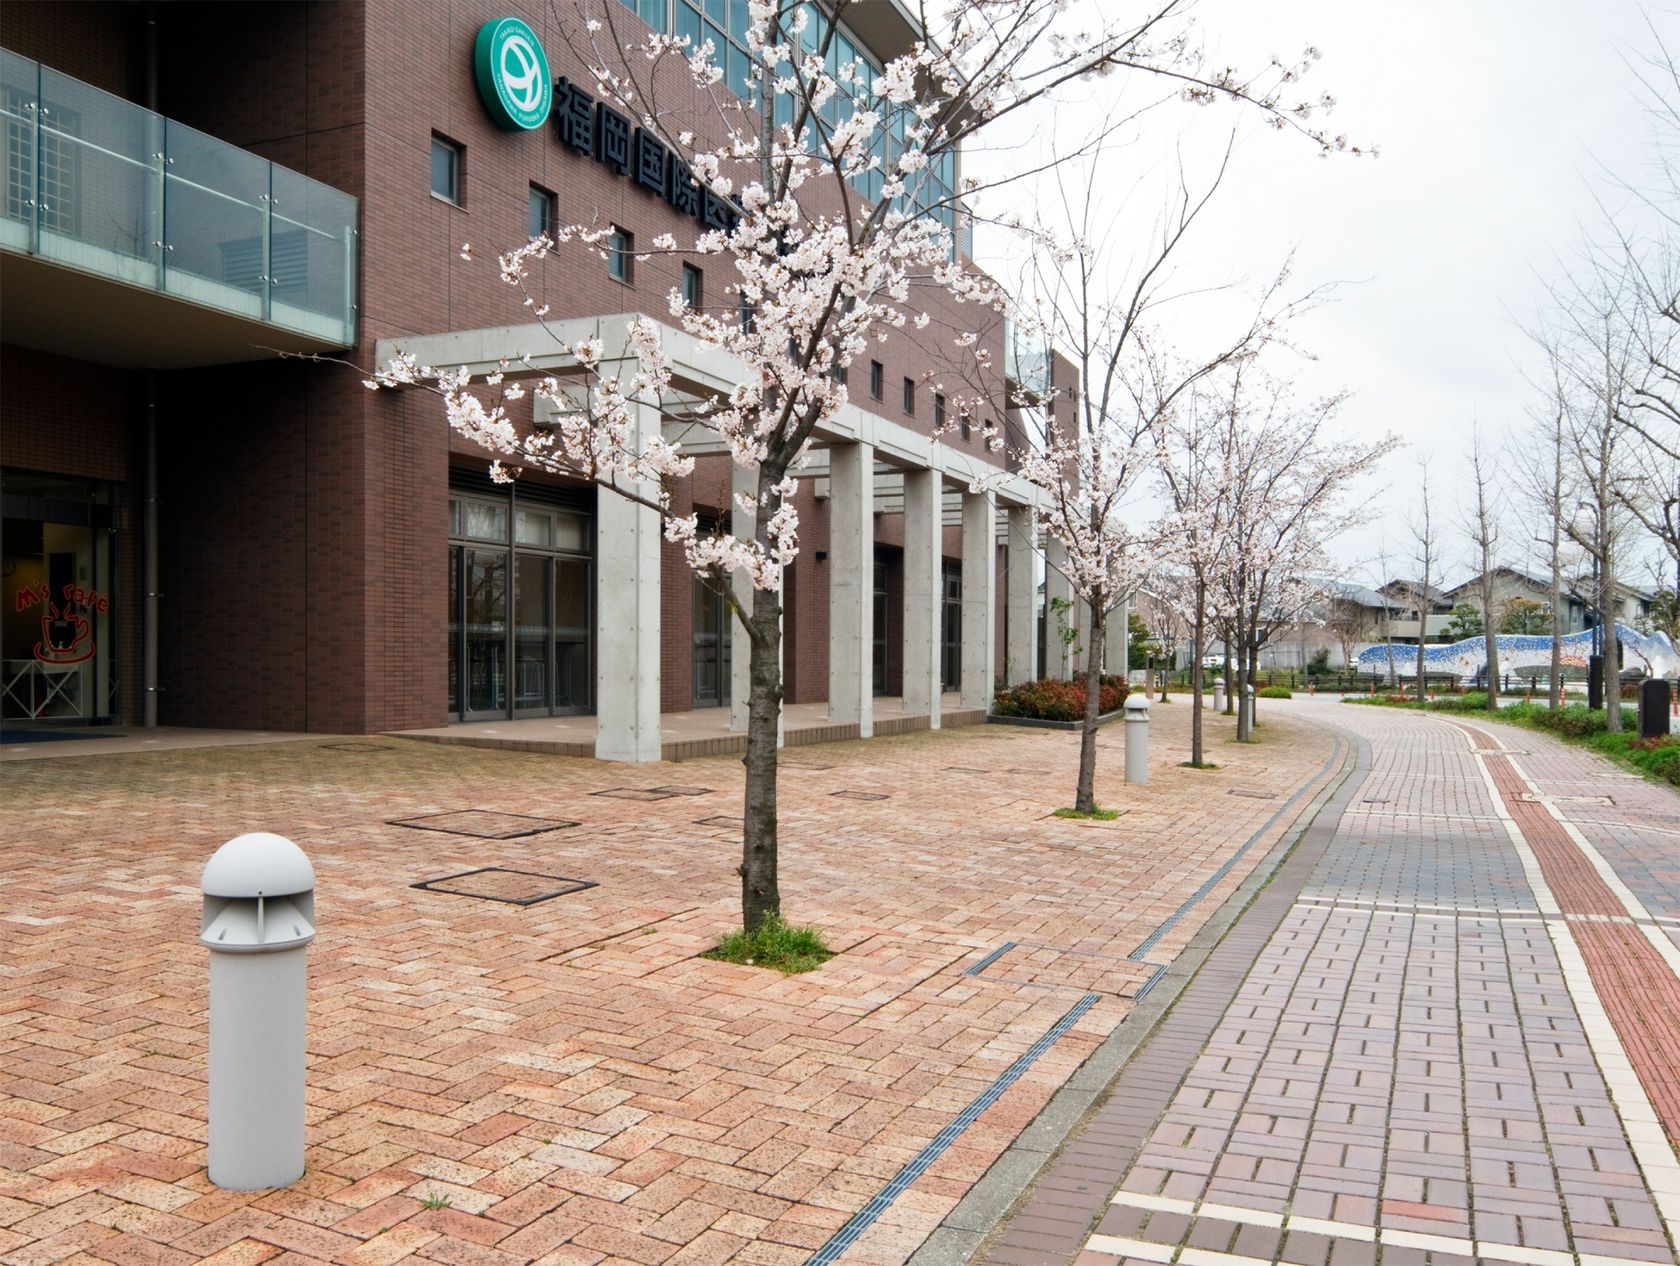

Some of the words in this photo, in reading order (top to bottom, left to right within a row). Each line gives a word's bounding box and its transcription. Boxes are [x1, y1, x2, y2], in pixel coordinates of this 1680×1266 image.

[555, 76, 749, 237] 福岡国際医
